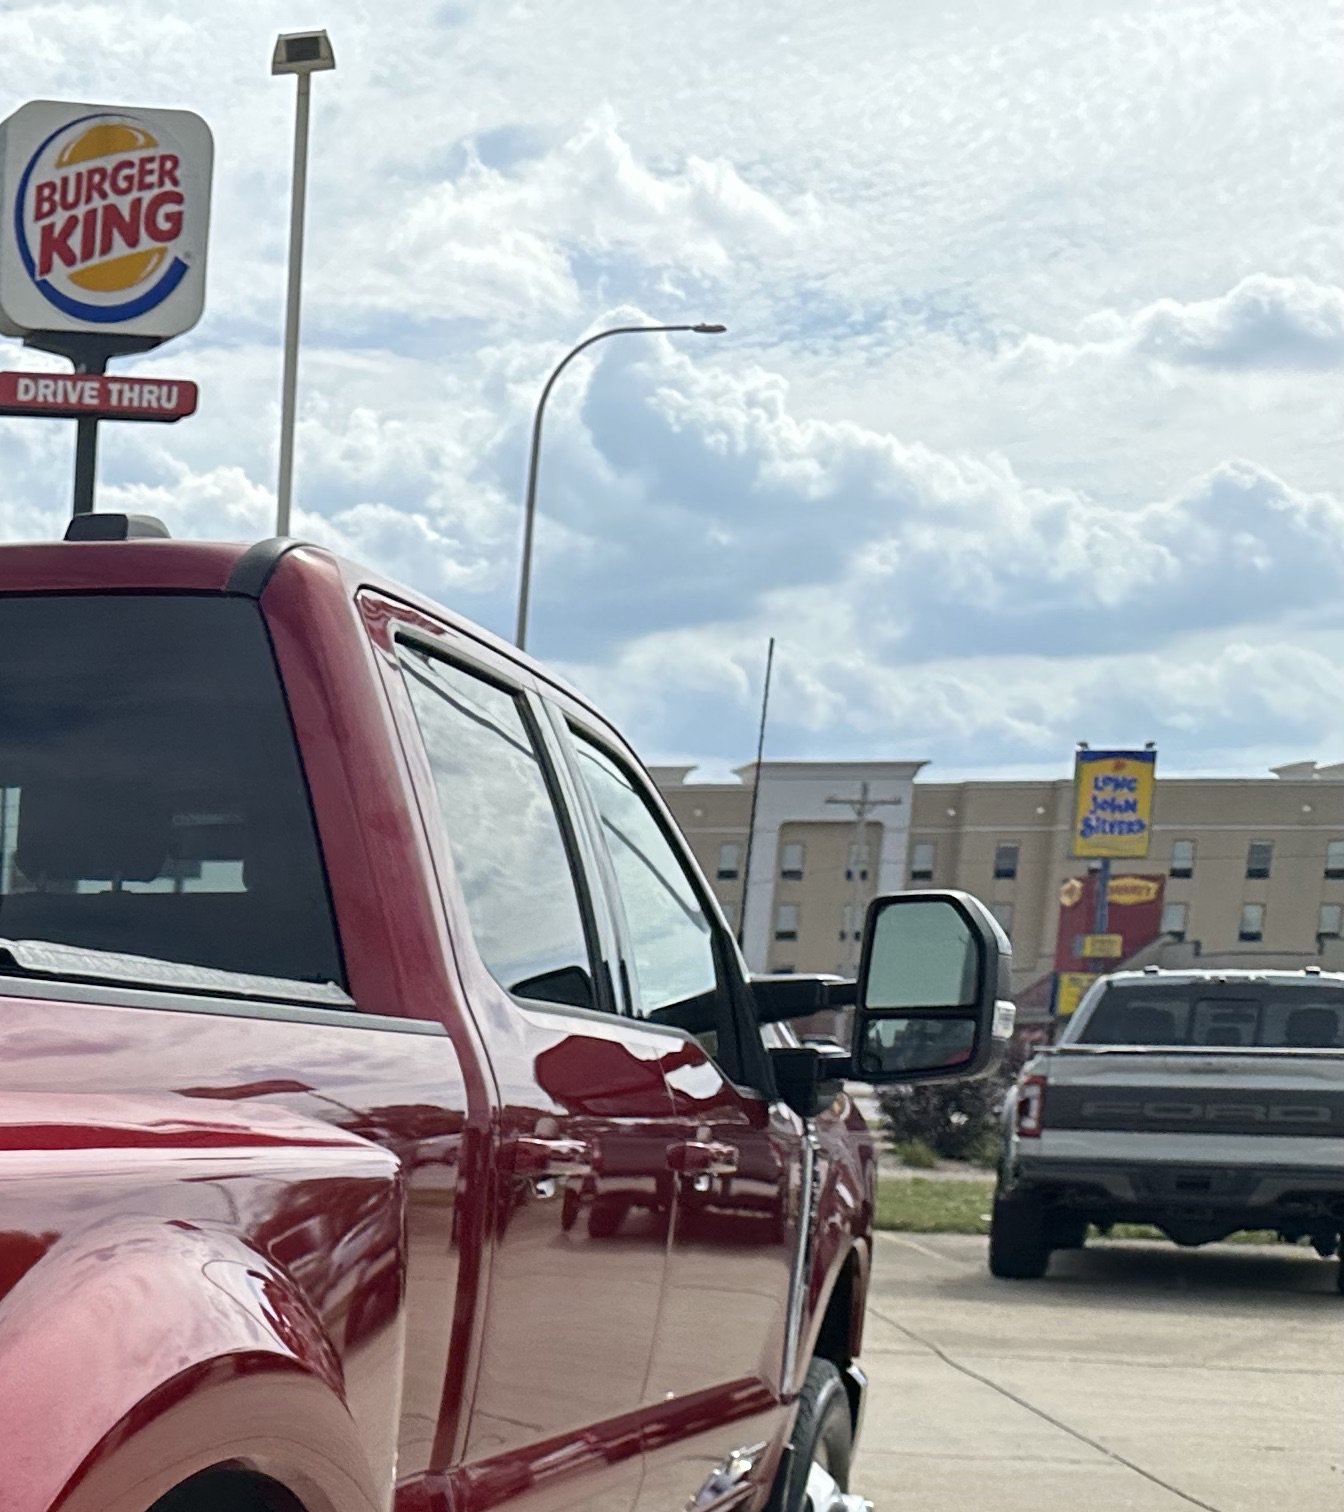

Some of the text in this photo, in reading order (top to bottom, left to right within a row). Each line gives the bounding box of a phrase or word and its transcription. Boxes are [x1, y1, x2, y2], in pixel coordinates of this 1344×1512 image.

[33, 153, 181, 222] BURGER
[35, 190, 185, 281] KING
[16, 376, 179, 410] DRIVE THRU
[1081, 1100, 1332, 1123] FORD
